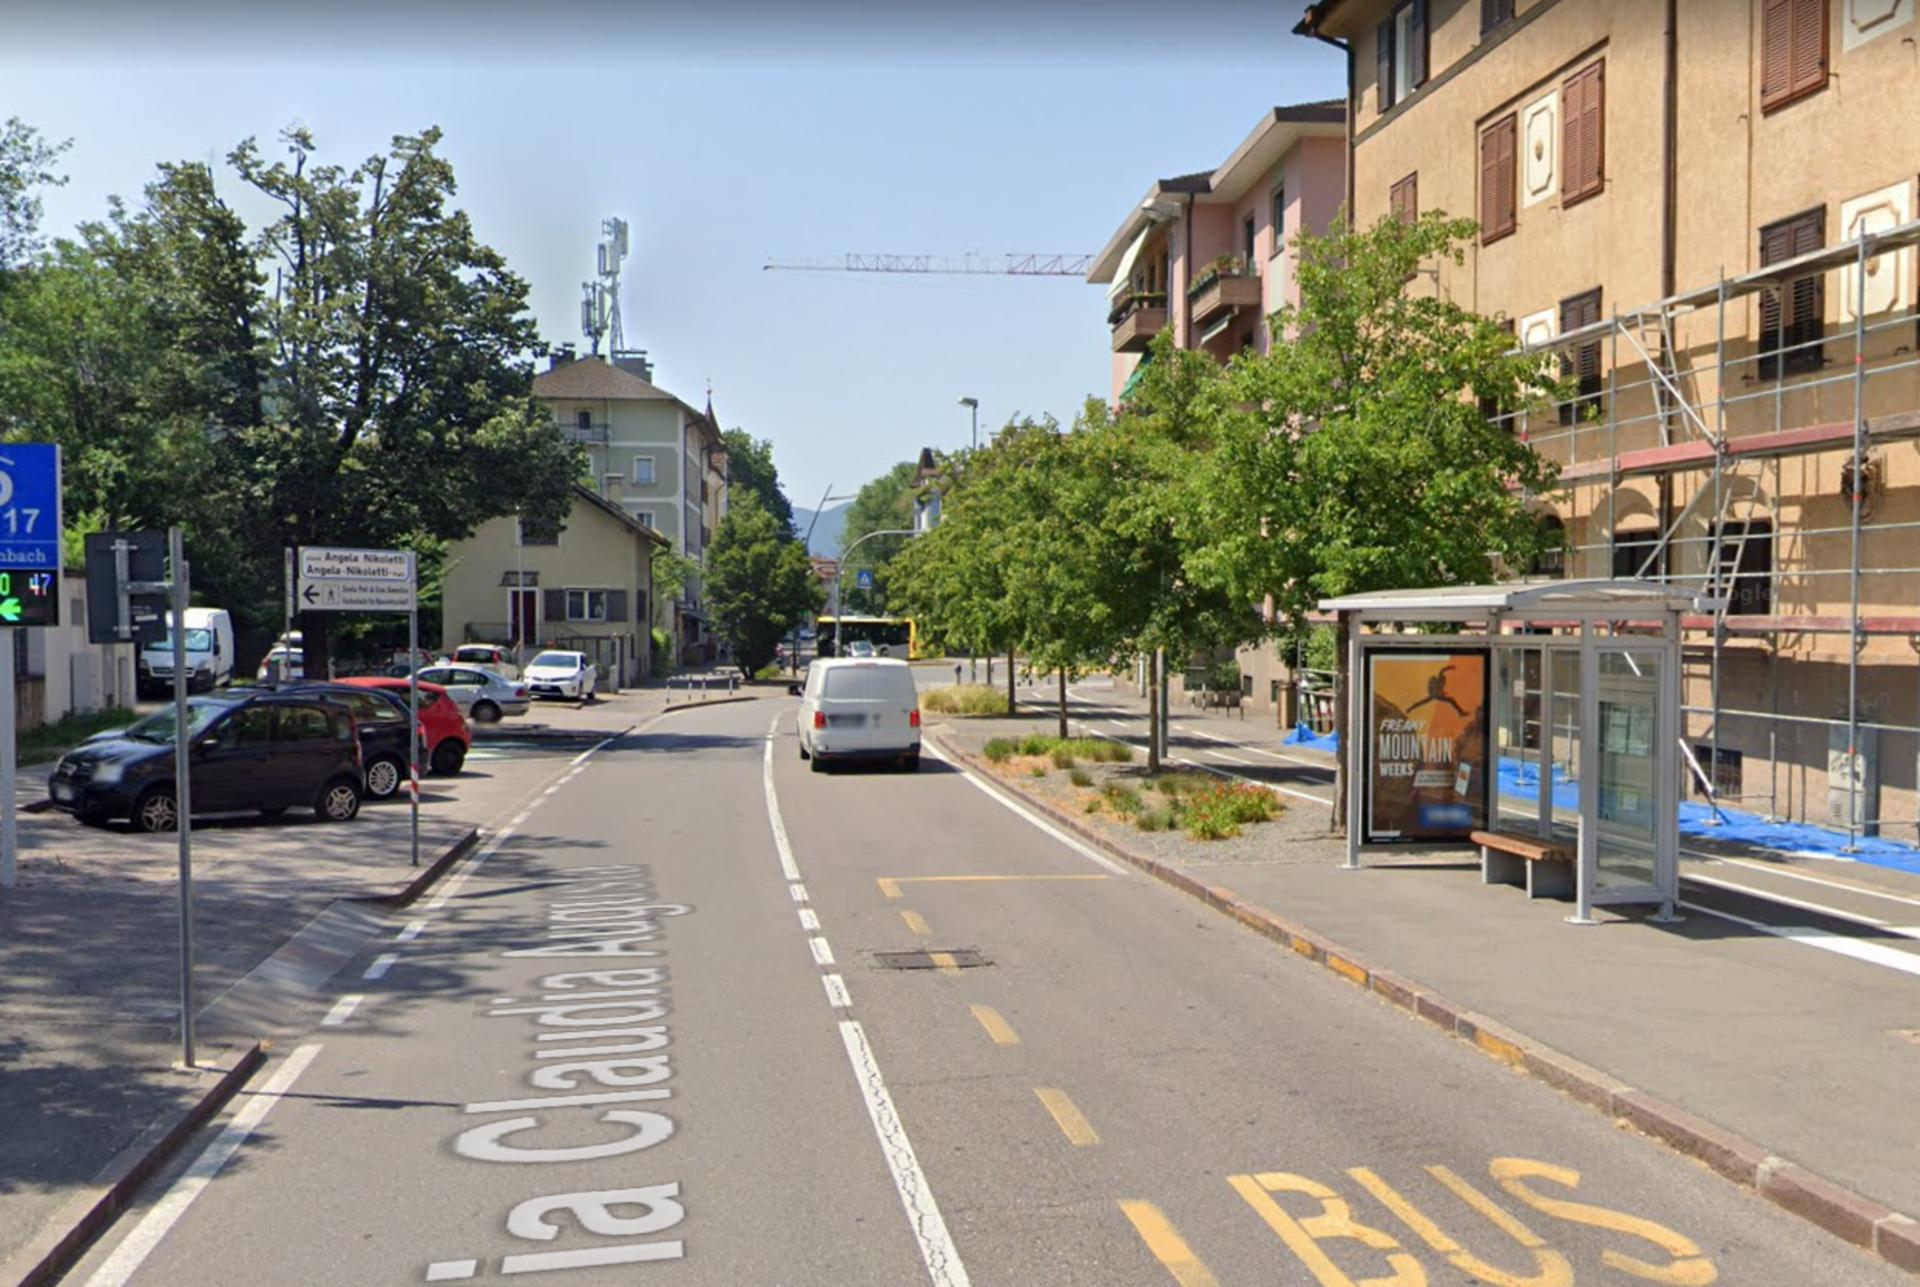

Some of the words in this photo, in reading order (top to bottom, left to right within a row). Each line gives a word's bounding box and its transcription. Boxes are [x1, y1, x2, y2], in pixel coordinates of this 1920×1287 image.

[325, 552, 358, 564] Angela
[29, 573, 51, 596] 47
[1379, 734, 1453, 763] MOUNTAIN
[1379, 762, 1414, 777] WEEKS
[1227, 1157, 1718, 1287] BUS
